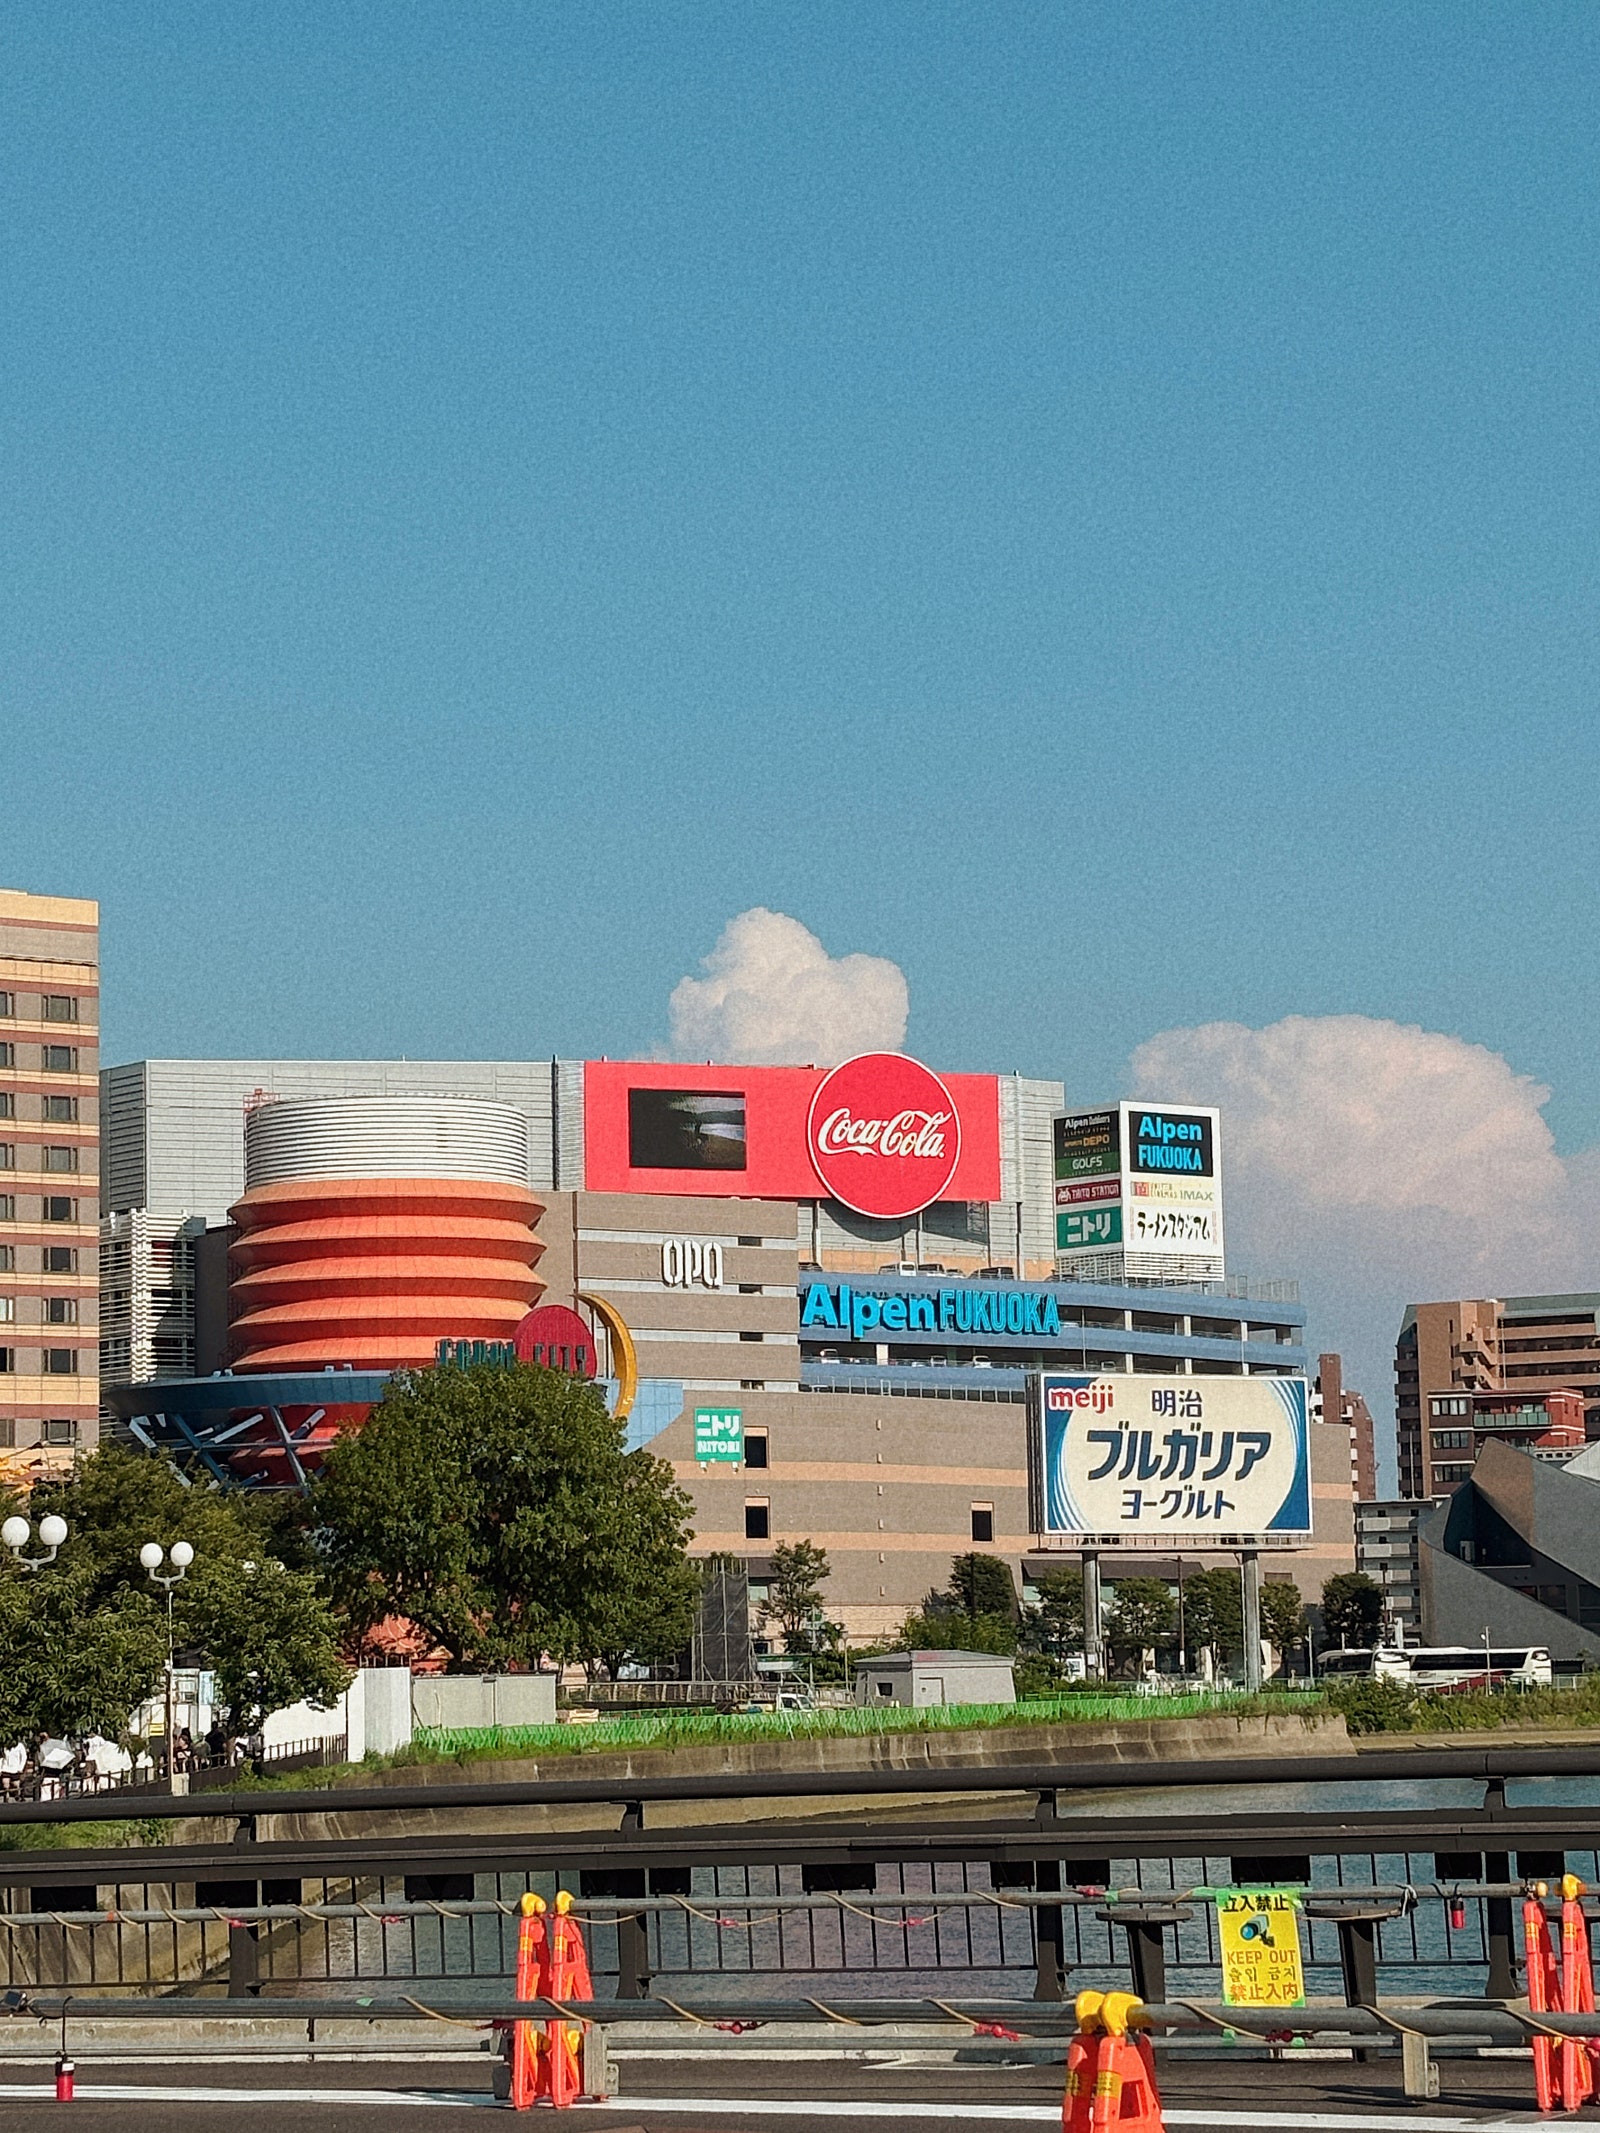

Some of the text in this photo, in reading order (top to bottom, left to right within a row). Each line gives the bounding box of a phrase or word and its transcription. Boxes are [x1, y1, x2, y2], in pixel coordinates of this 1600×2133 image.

[818, 1108, 952, 1158] Coca-Cola
[1065, 1118, 1088, 1130] Alpen
[1139, 1116, 1202, 1144] Alpen
[1083, 1134, 1109, 1147] DEPO
[1138, 1144, 1203, 1171] FUKUOKA
[1072, 1184, 1119, 1199] TAITO STATION
[1180, 1190, 1213, 1201] IMAX
[1067, 1213, 1110, 1243] ニトリ
[801, 1284, 1061, 1338] Alpen FUKUOKA
[1051, 1385, 1114, 1413] meiji
[1151, 1389, 1203, 1417] 明治
[697, 1414, 740, 1437] ニトリ
[697, 1440, 740, 1454] NITORI
[1087, 1421, 1271, 1481] ブルガリア
[1121, 1485, 1235, 1519] ヨーグルト
[1223, 1893, 1290, 1912] 立入禁止
[1227, 1949, 1296, 1965] KEEP OUT
[1230, 1982, 1299, 2001] 禁止入内
